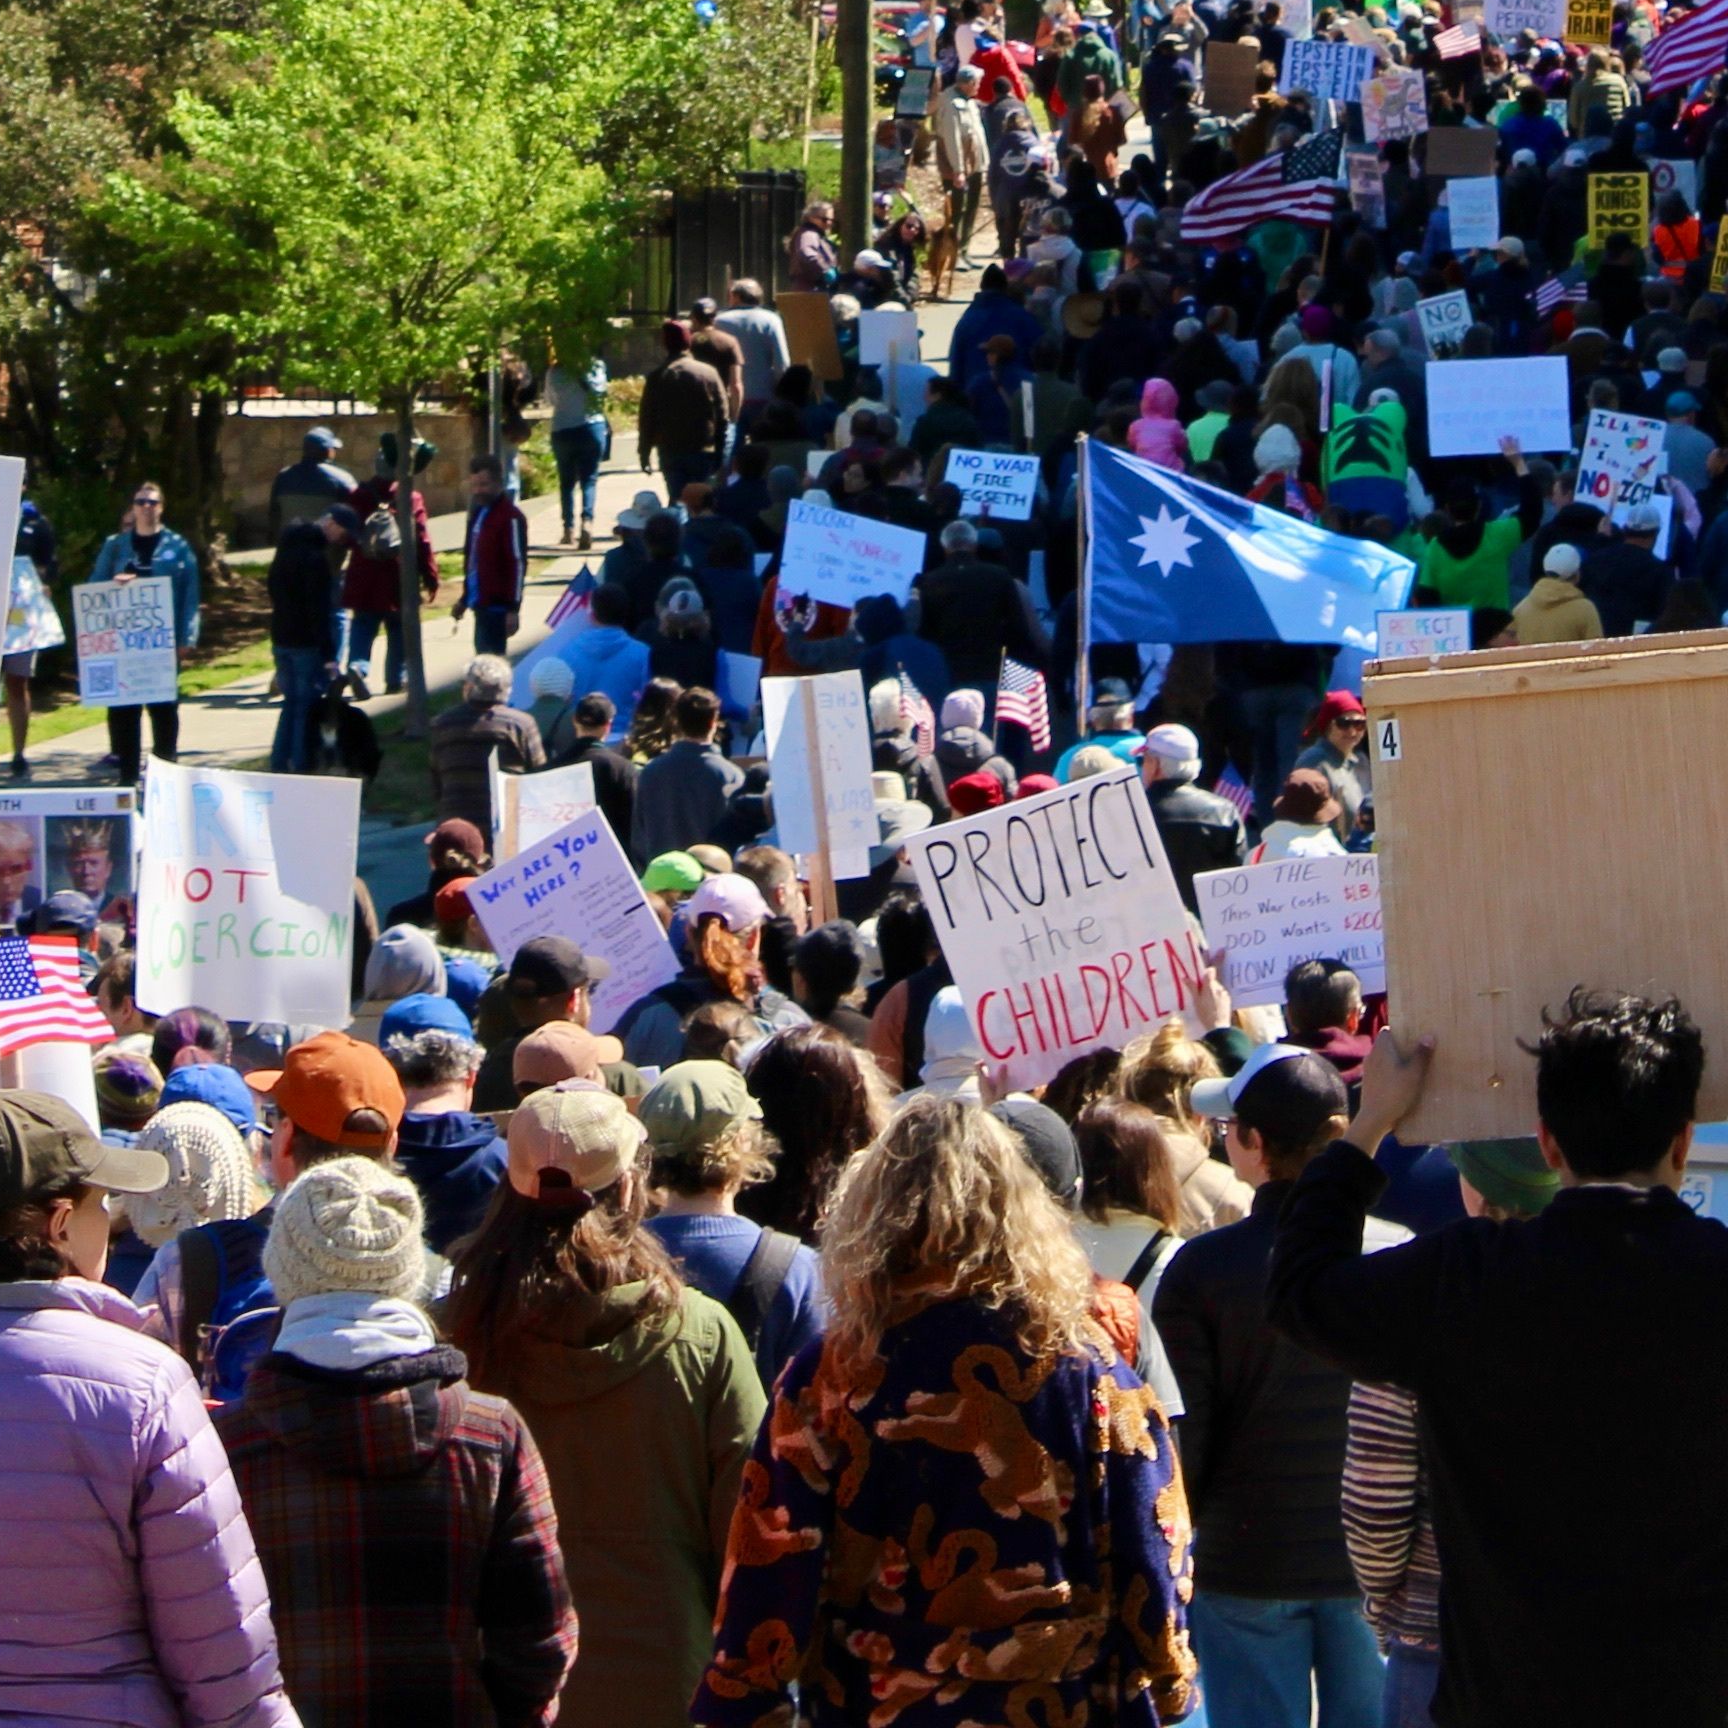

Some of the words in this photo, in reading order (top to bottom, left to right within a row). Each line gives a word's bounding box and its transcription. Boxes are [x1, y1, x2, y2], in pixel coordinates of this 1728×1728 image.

[1569, 0, 1611, 13] OFF
[1291, 39, 1369, 63] EPSTEIN
[1290, 59, 1366, 81] EPSTEIN
[1595, 175, 1641, 189] NO
[1595, 189, 1641, 211] KINGS
[1595, 212, 1641, 228] NO
[1425, 301, 1462, 328] NO
[954, 453, 984, 469] NO
[993, 456, 1035, 473] WAR
[972, 472, 1014, 488] FIRE
[1577, 469, 1611, 498] NO
[962, 486, 1027, 507] EGSETH
[128, 583, 162, 609] LET
[1382, 721, 1398, 758] 4
[75, 798, 98, 812] LIE
[146, 776, 275, 861] CARE
[480, 874, 516, 904] WHY
[523, 854, 553, 881] ARE
[553, 829, 599, 859] YOU
[925, 774, 1156, 930] PROTECT
[165, 863, 270, 905] NOT
[524, 872, 567, 909] HERE
[1211, 873, 1249, 899] DO
[1273, 862, 1321, 884] THE
[1221, 903, 1252, 924] This
[1257, 897, 1286, 915] War
[1291, 891, 1331, 910] Costs
[148, 905, 349, 981] COERCION
[1018, 914, 1103, 962] the
[1225, 929, 1267, 951] DOD
[1281, 920, 1332, 939] Wants
[1230, 956, 1277, 989] HOW
[975, 929, 1207, 1061] CHILDREN
